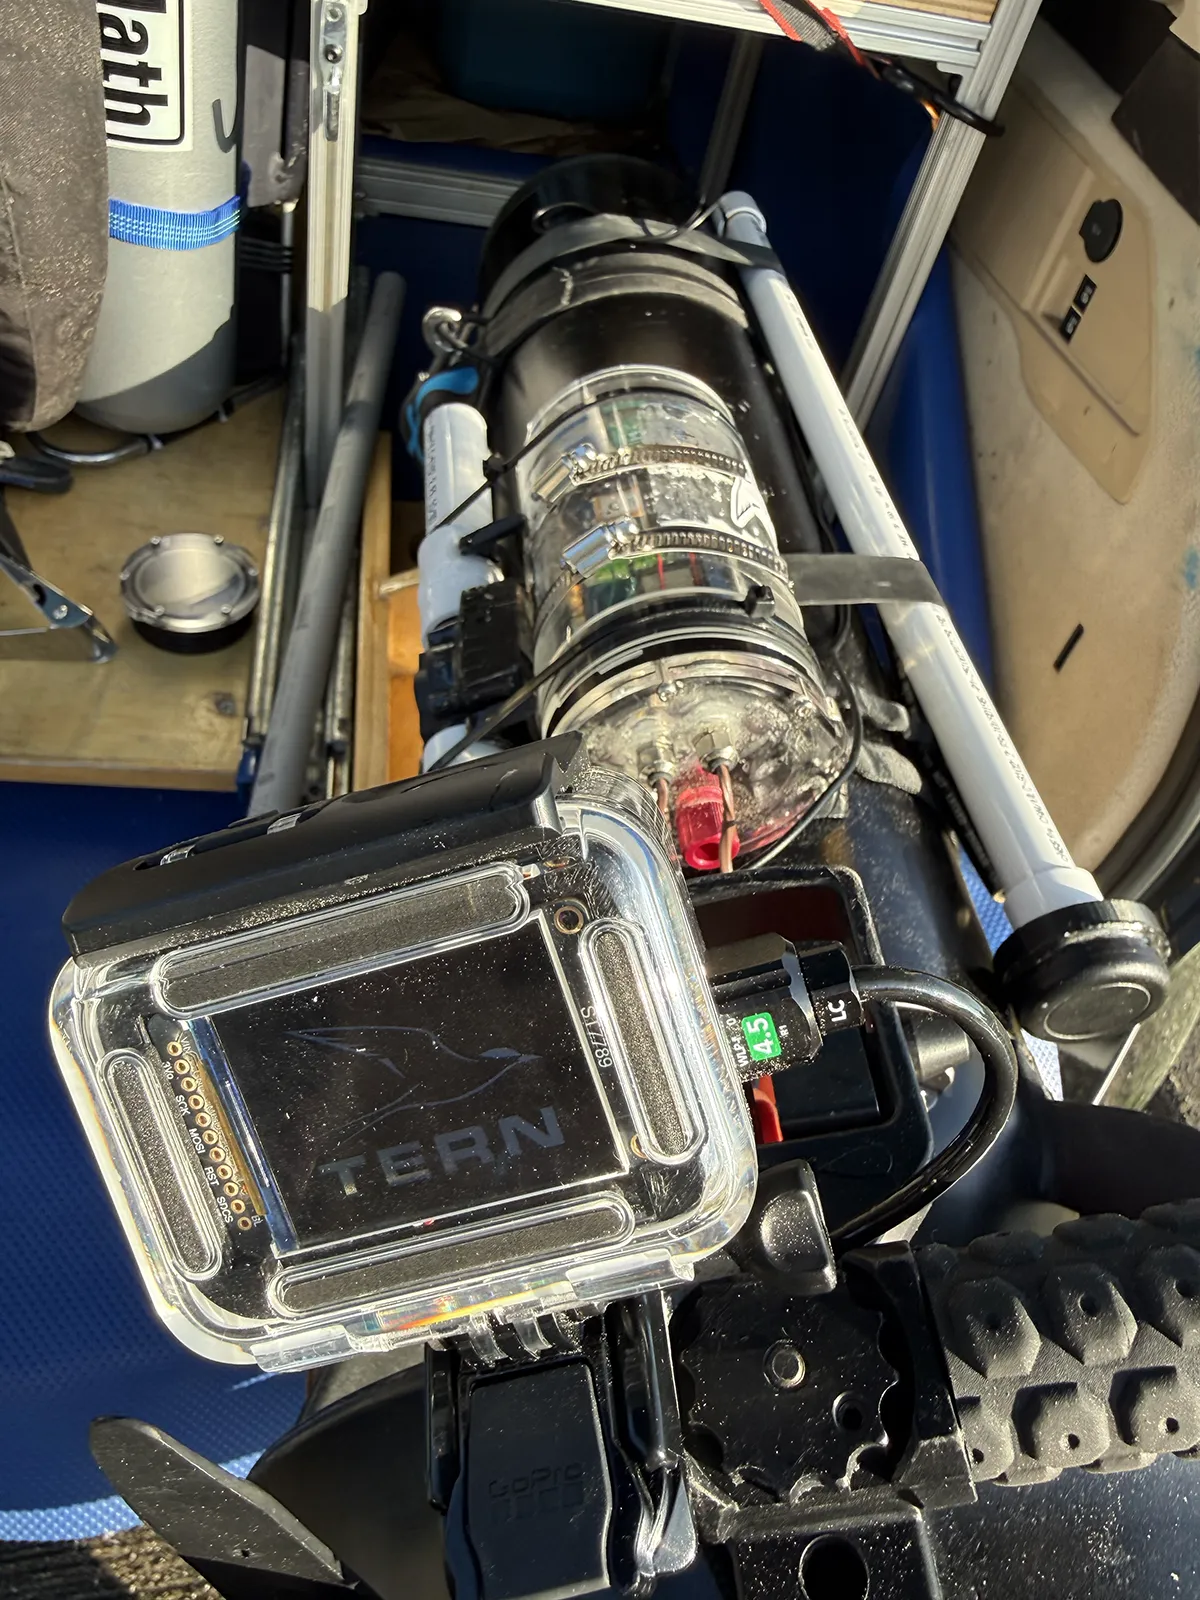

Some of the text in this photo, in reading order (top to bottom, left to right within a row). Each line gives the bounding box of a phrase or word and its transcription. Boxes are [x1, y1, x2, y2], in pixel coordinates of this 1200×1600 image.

[828, 999, 848, 1022] LC
[745, 1017, 774, 1055] 4.5
[175, 1095, 191, 1116] SCK
[189, 1128, 206, 1154] MOSI
[318, 1106, 565, 1195] TERN
[204, 1166, 220, 1187] RST
[217, 1196, 234, 1223] SDCS
